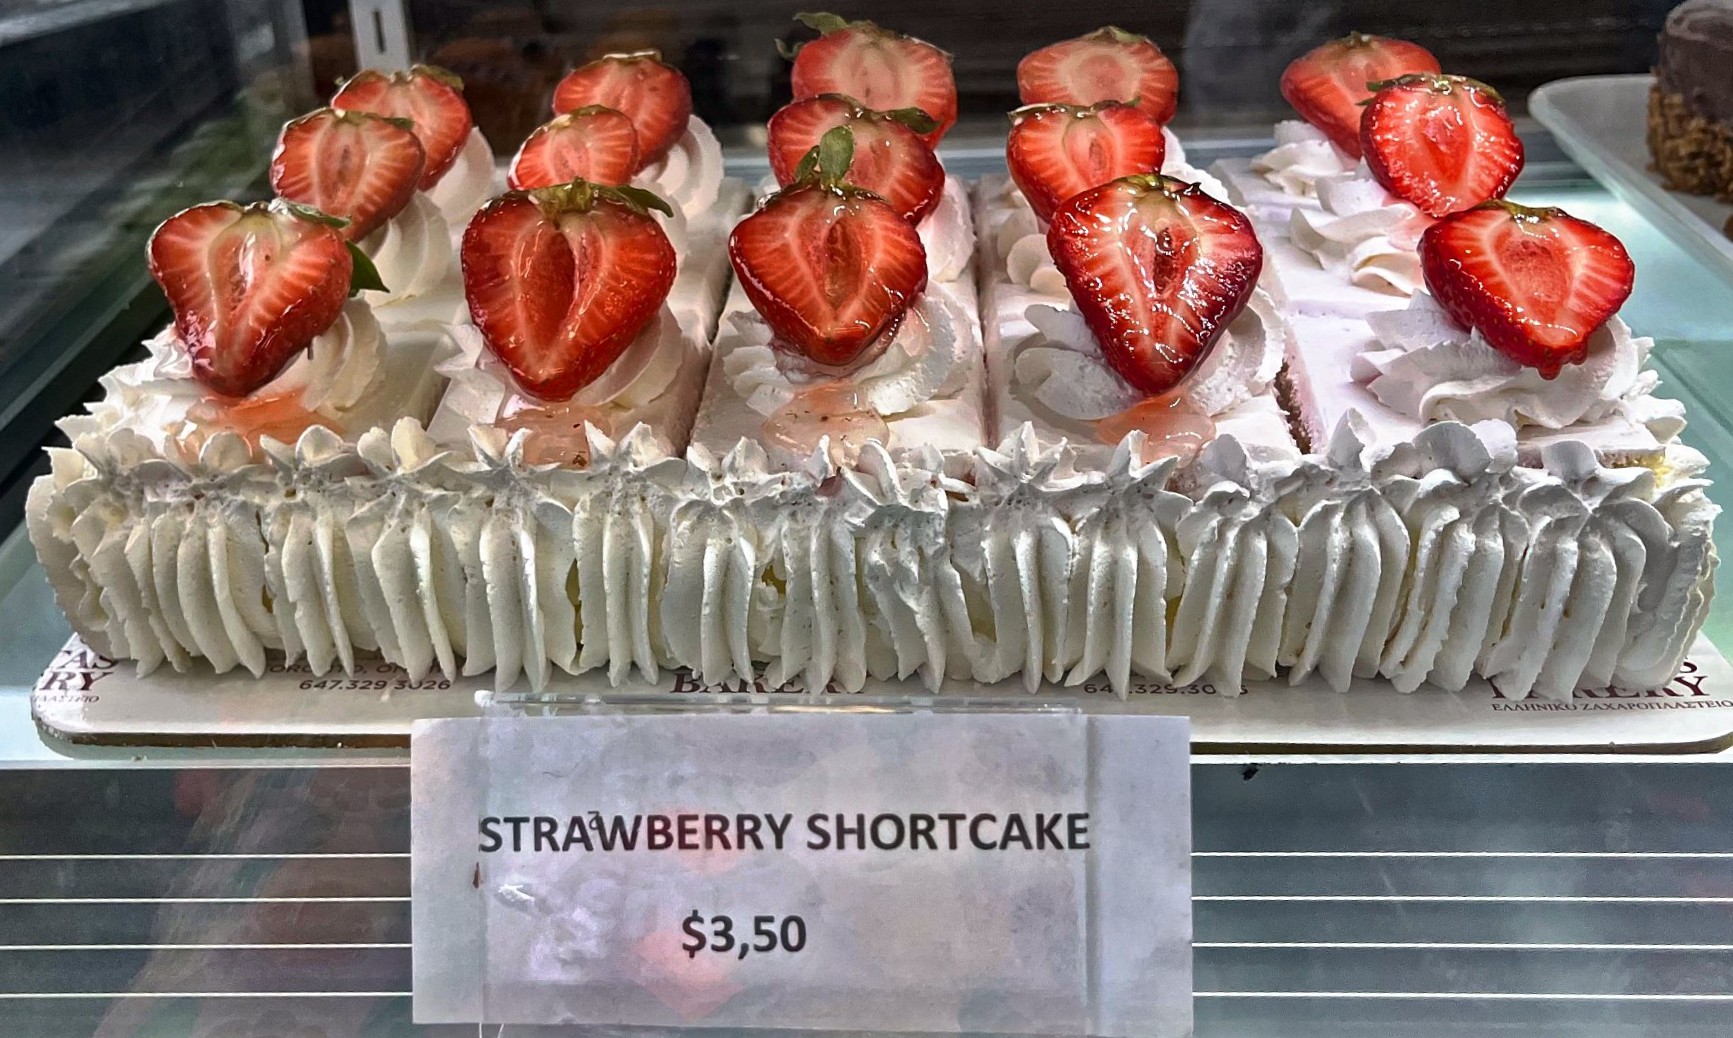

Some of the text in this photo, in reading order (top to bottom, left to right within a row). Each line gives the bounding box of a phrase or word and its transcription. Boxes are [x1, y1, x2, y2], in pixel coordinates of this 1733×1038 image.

[479, 812, 1090, 852] STRAWBERRY SHORTCAKE
[682, 909, 807, 960] $3,50
